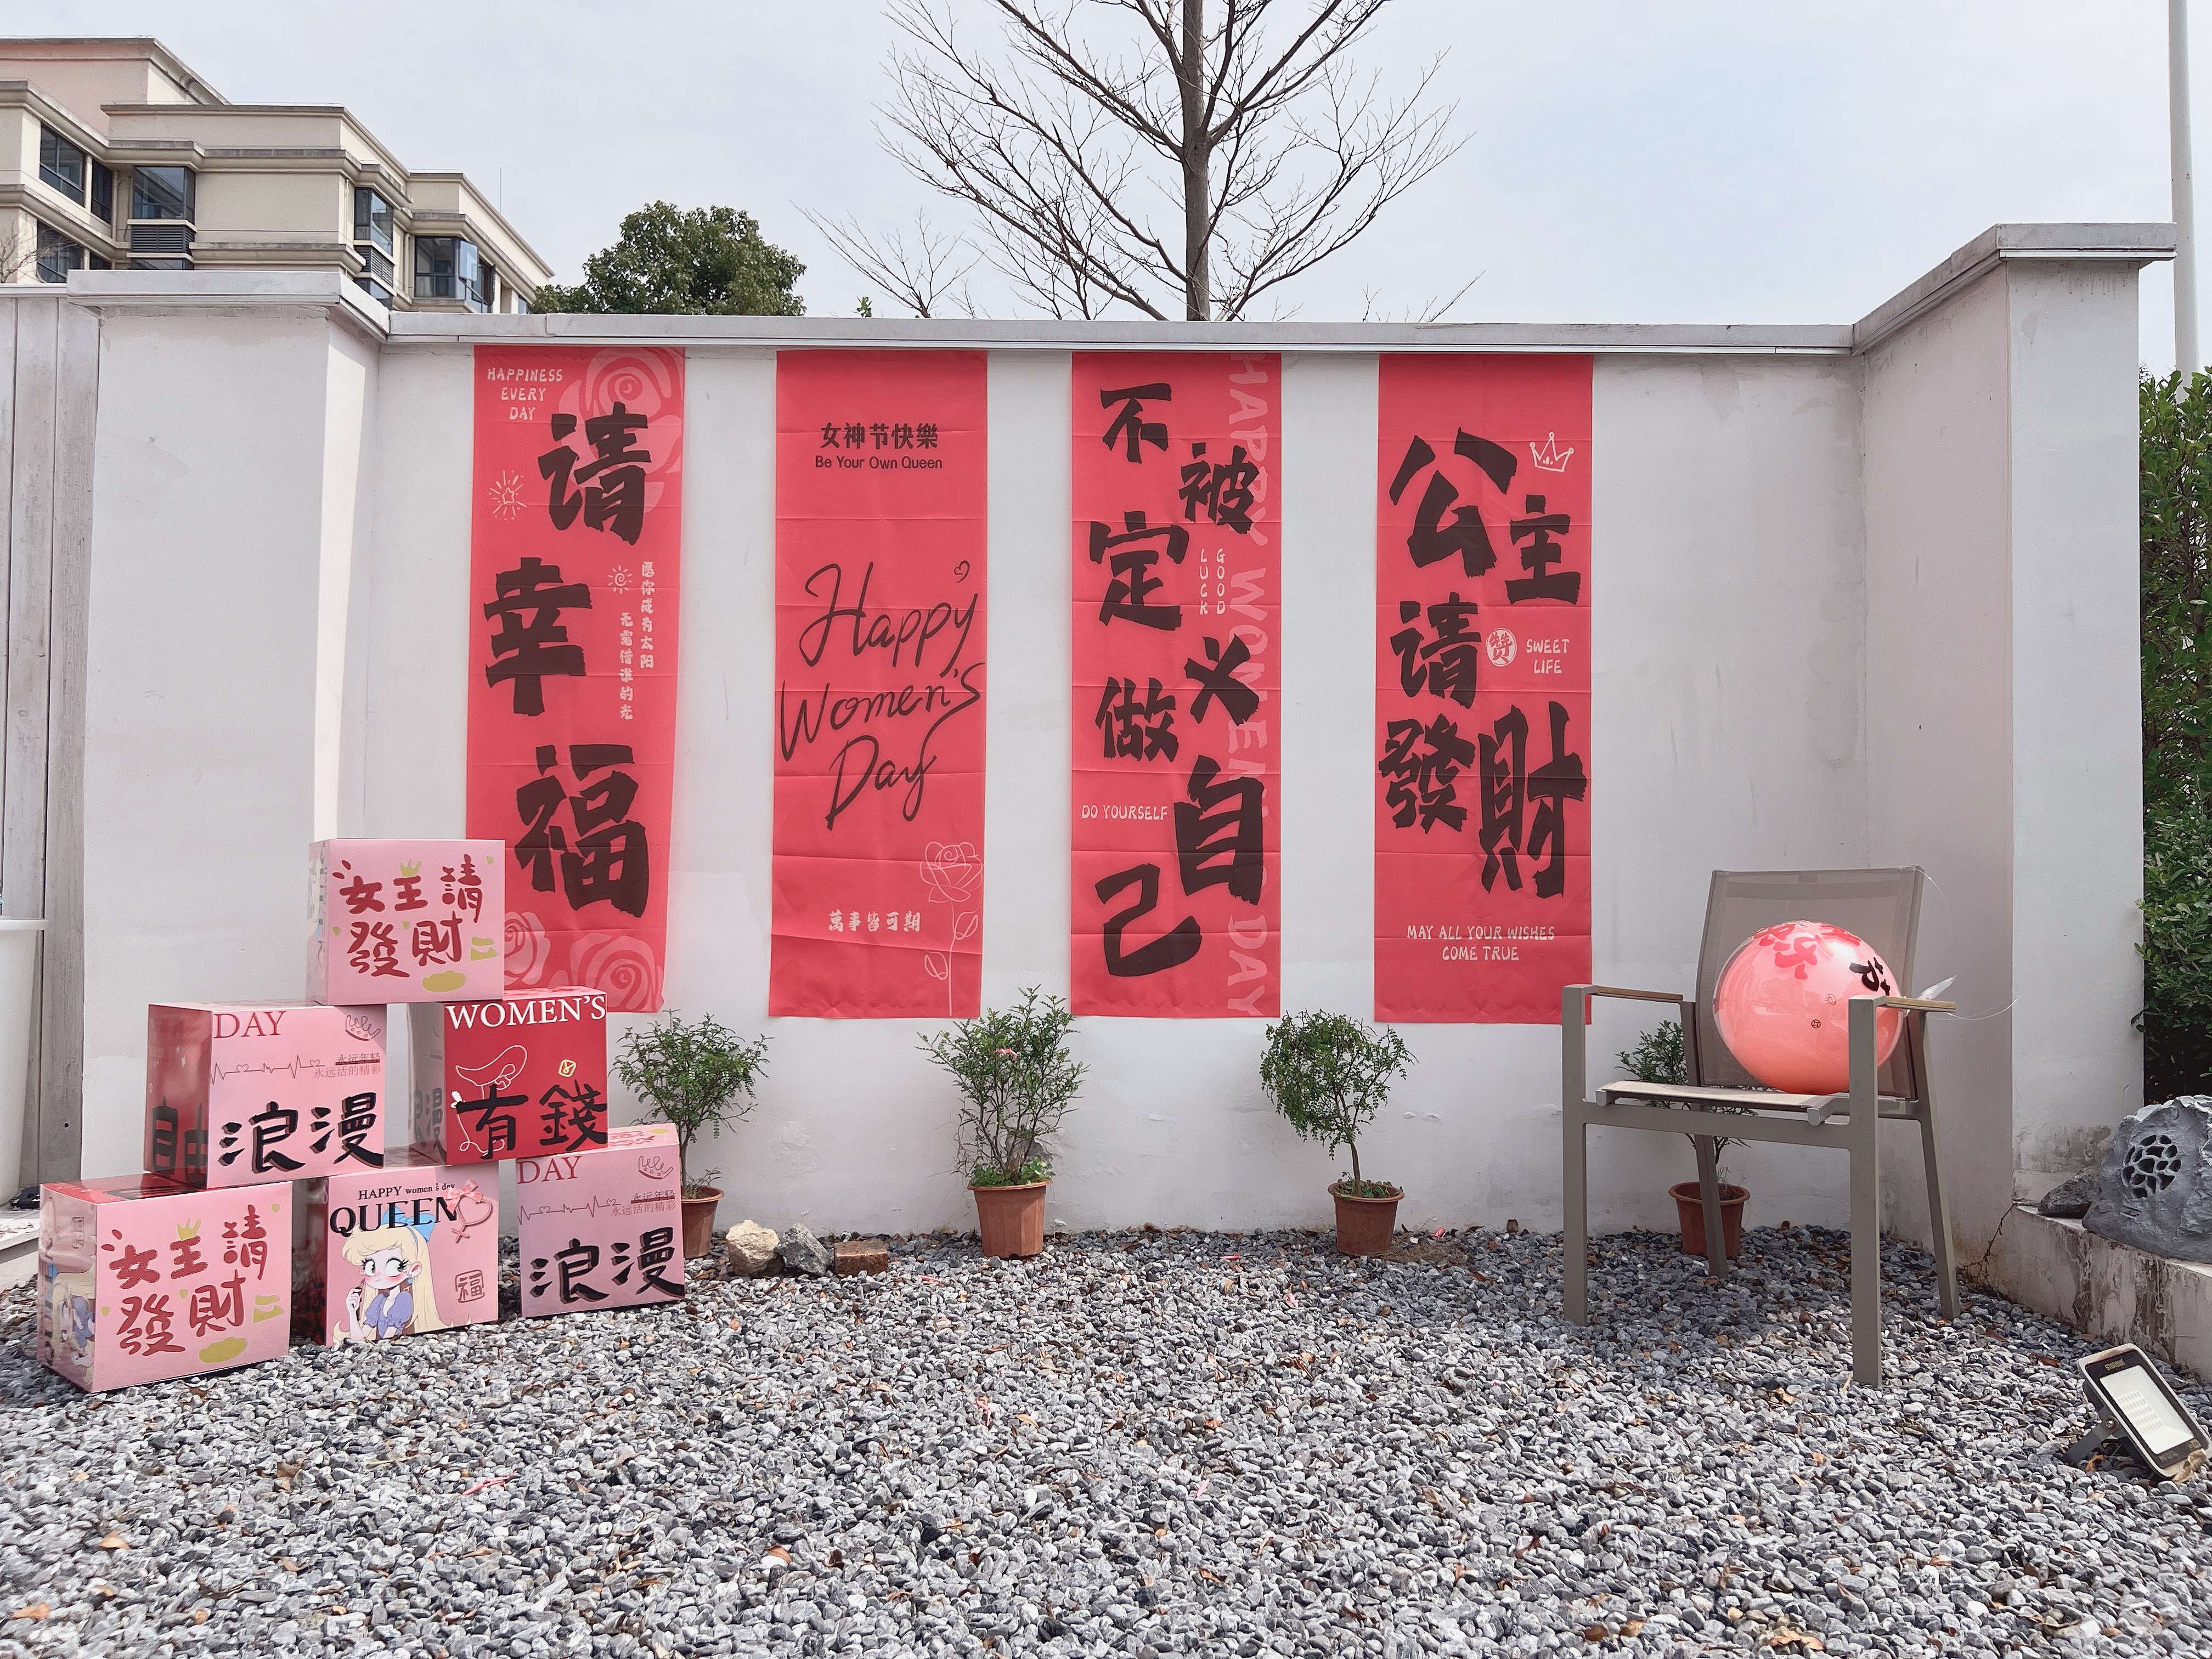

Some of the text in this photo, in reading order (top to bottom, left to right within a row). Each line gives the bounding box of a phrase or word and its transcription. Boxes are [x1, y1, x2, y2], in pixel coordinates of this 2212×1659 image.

[487, 368, 563, 382] HAPPINESS
[501, 387, 546, 402] EVERY
[509, 407, 535, 421] DAY
[820, 422, 938, 449] 女神节快樂
[815, 455, 943, 470] Be Your Own Queen
[1199, 549, 1208, 614] LUCK
[1216, 548, 1226, 614] GOOD
[640, 561, 655, 669] 愿你成为太阳
[799, 561, 978, 678] Happy
[1487, 630, 1514, 665] 赞
[1526, 639, 1570, 653] SWEET
[619, 612, 634, 720] 无需借谁的光
[1534, 659, 1562, 674] LIFE
[781, 663, 985, 761] Women's
[825, 735, 936, 831] Day
[1081, 804, 1168, 820] DO YOURSELF
[338, 854, 483, 923] 女王請
[828, 909, 921, 932] 萬事皆可期
[1407, 925, 1555, 940] MAY ALL YOUR WISHES
[347, 911, 463, 978] 發財
[1442, 946, 1519, 961] COME TRUE
[1228, 915, 1268, 1017] DAY
[213, 1011, 286, 1039] DAY
[445, 996, 606, 1029] WOMEN'S
[313, 1064, 381, 1079] 永远活的精彩
[218, 1092, 384, 1173] 浪漫
[456, 1079, 607, 1159] 有錢
[517, 1155, 582, 1184] DAY
[358, 1186, 402, 1200] HAPPY
[611, 1199, 676, 1217] 永远活的精彩
[330, 1197, 458, 1237] QUEEN
[109, 1204, 267, 1289] 女王請
[529, 1227, 685, 1305] 浪漫
[458, 1273, 483, 1301] 福
[116, 1269, 246, 1357] 發財
